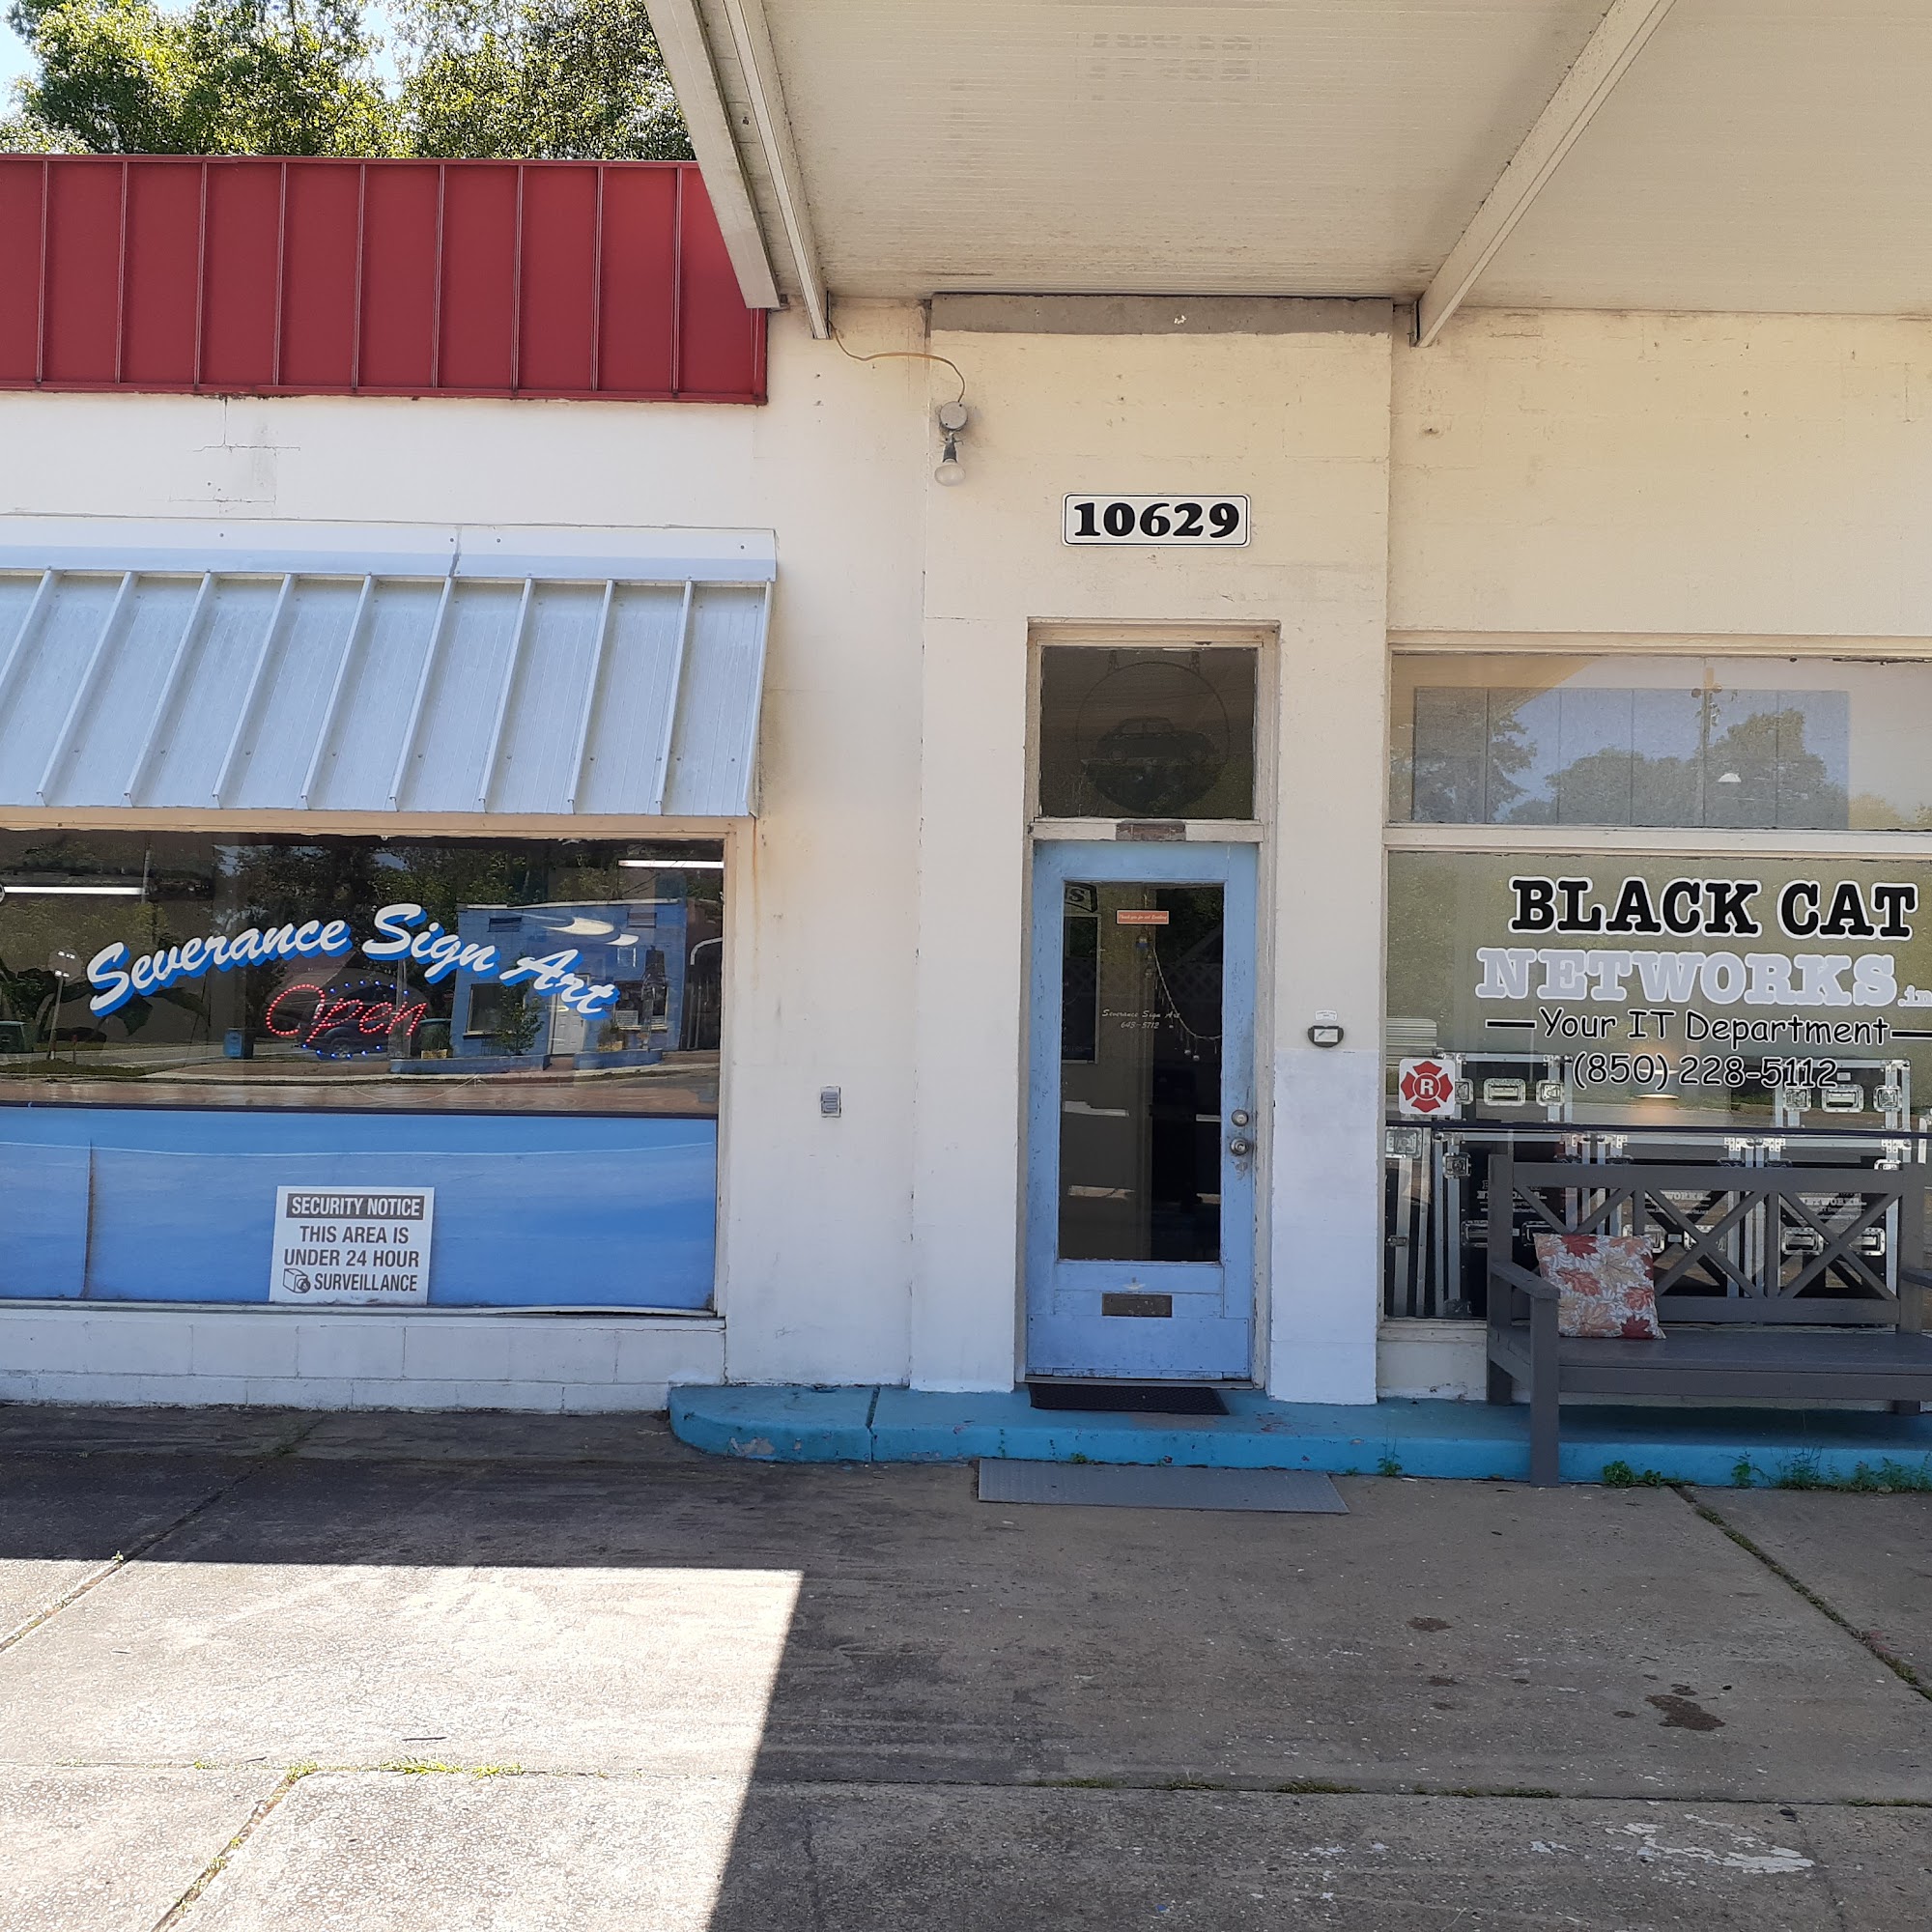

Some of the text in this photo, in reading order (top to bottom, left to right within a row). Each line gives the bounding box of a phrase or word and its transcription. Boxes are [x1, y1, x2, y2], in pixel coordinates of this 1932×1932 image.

[1073, 502, 1240, 538] 10629
[1508, 876, 1918, 941] BLACK CAT
[87, 903, 619, 1019] Severance Sign Art
[1475, 947, 1897, 1007] NETWORKS
[266, 983, 428, 1043] Open
[1539, 1007, 1889, 1051] Your IT Department
[1420, 1078, 1435, 1095] R
[1573, 1051, 1838, 1092] (850) 228-5112
[292, 1196, 421, 1216] SECURITY NOTICE
[299, 1225, 410, 1244] THIS AREA IS
[283, 1248, 419, 1267] UNDER 24 HOUR
[314, 1272, 418, 1292] SURVEILLANCE
